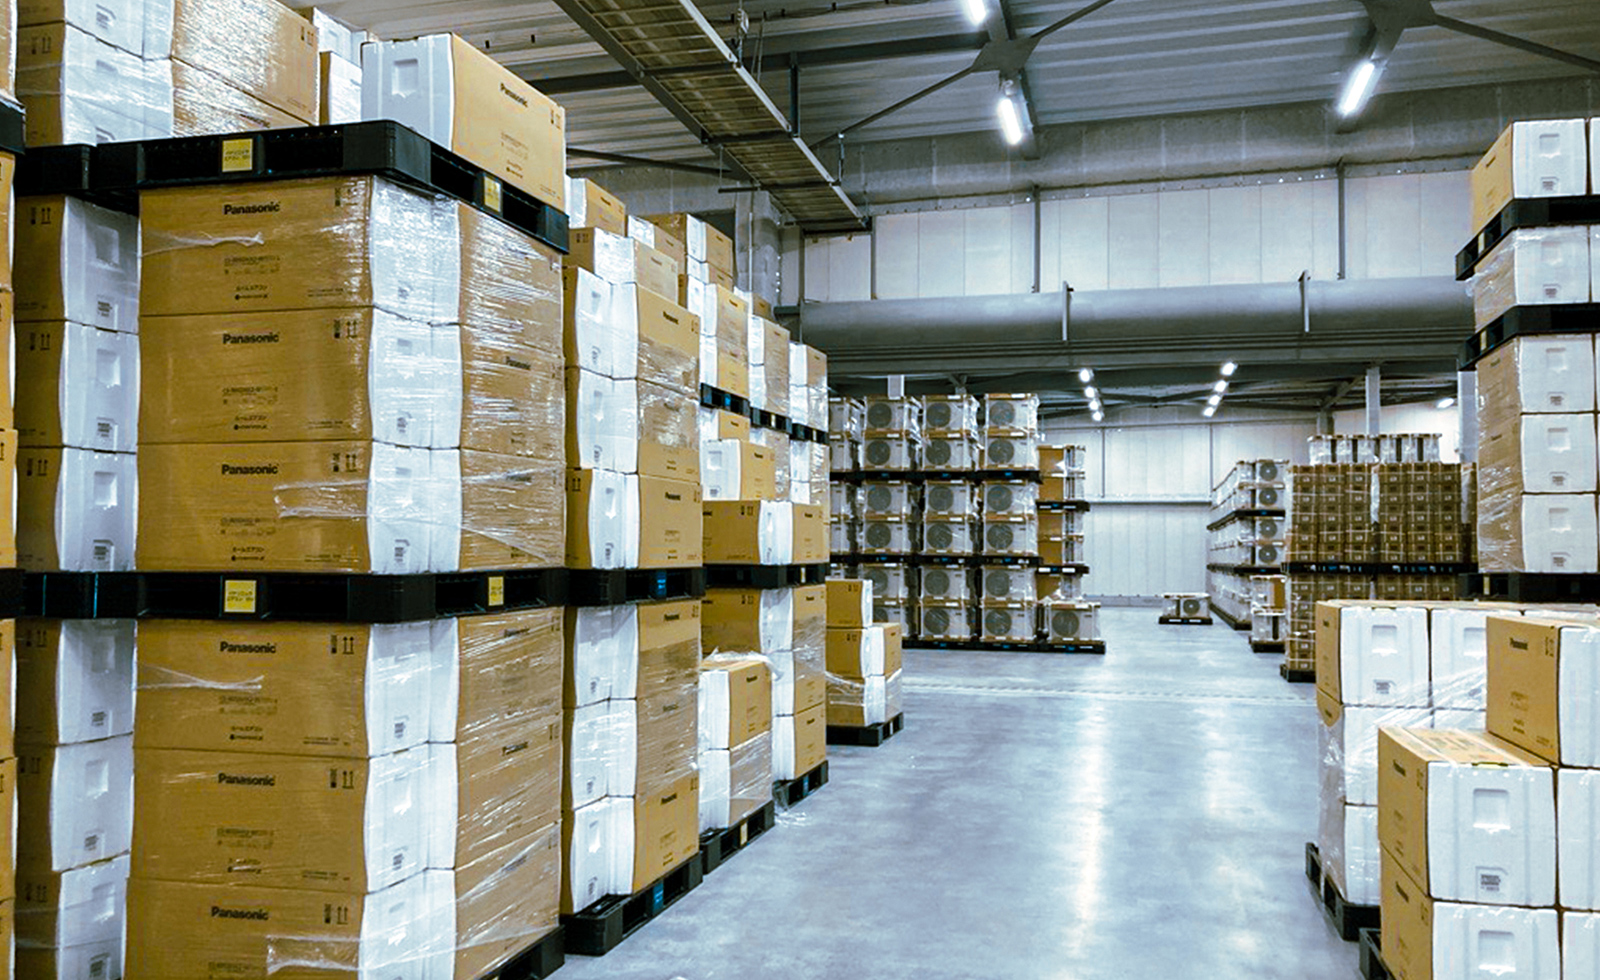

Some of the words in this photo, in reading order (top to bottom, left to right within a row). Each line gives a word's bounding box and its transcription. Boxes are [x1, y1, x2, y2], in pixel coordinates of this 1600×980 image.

[224, 201, 280, 215] Panasonic
[223, 332, 279, 345] Panasonic
[222, 463, 279, 475] Panasonic
[220, 641, 277, 654] Panasonic
[218, 773, 276, 787] Panasonic
[211, 906, 269, 921] Panasonic
